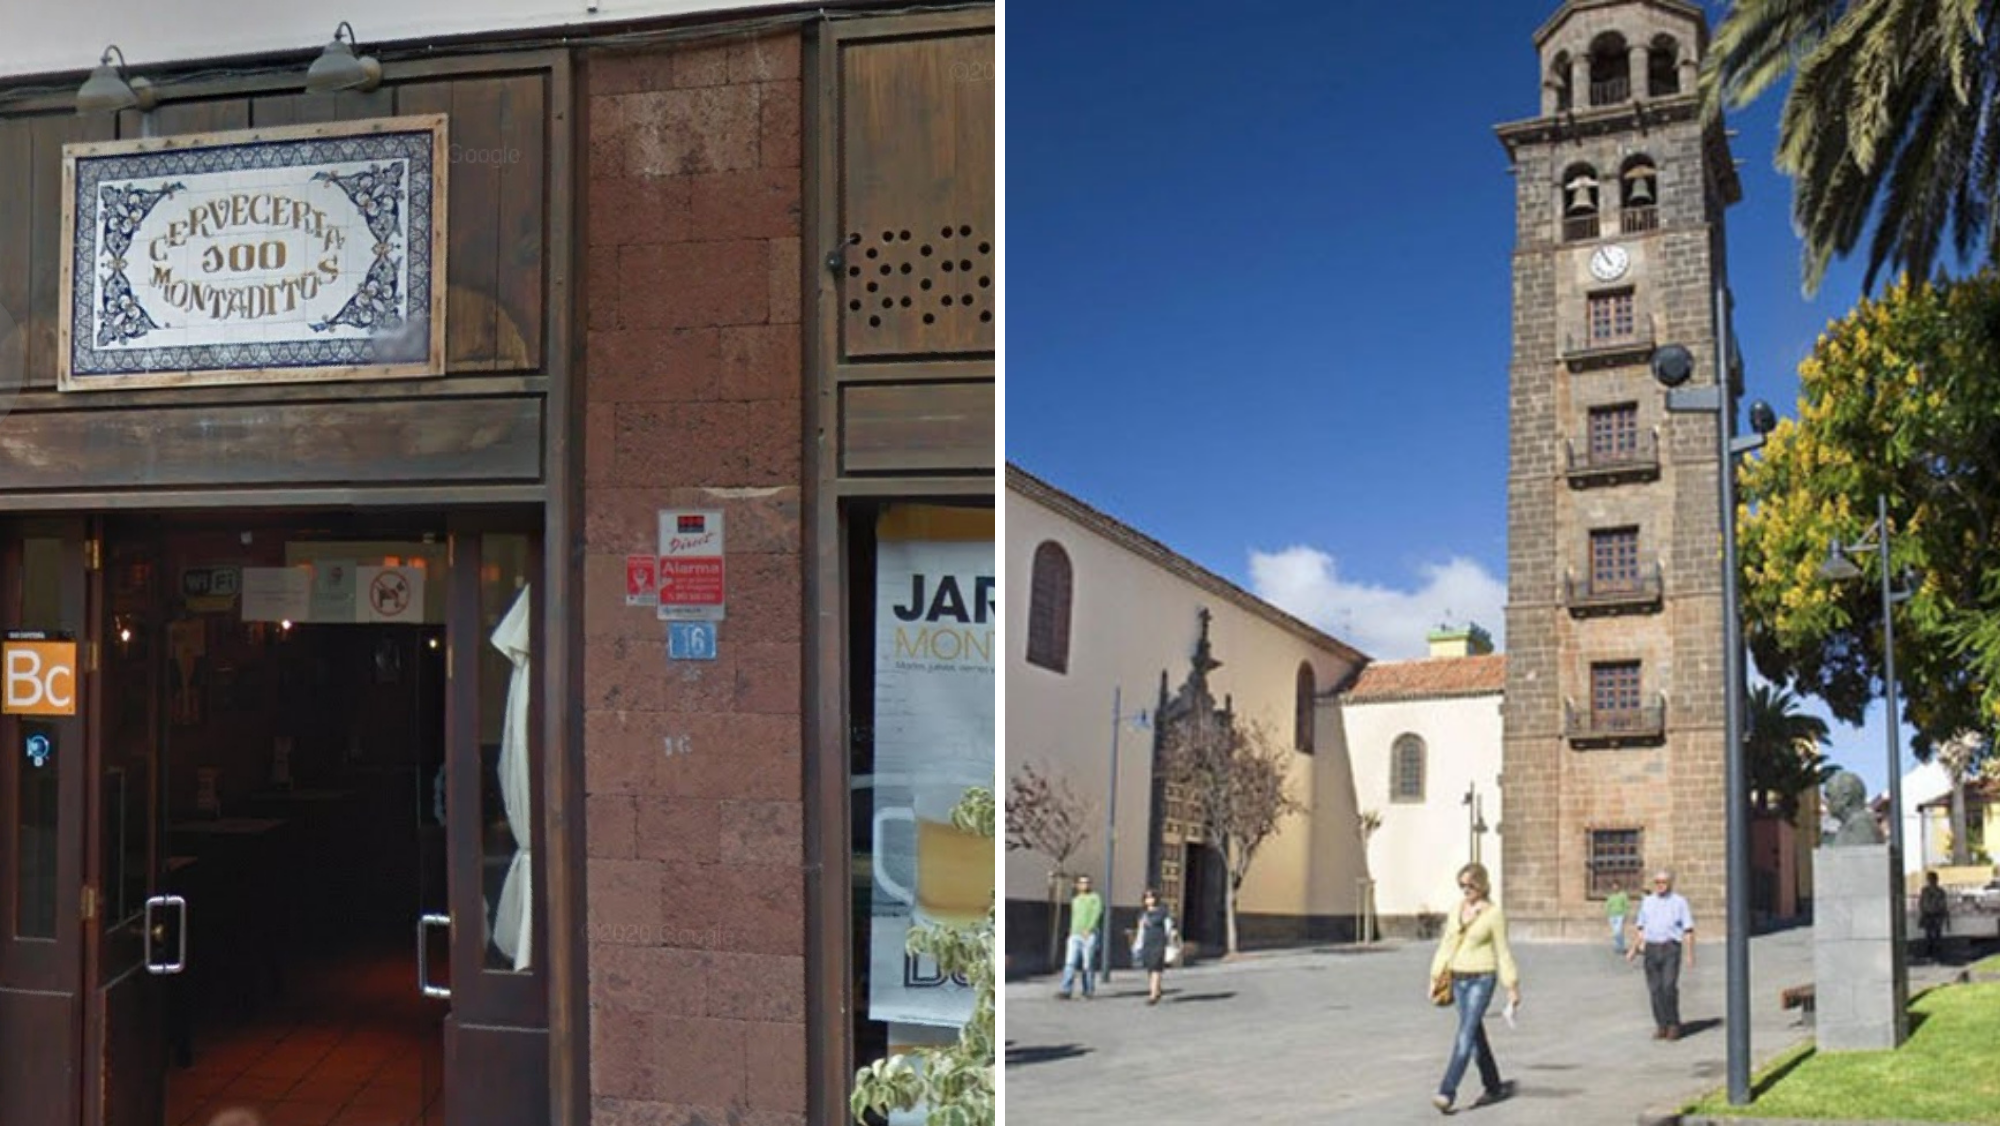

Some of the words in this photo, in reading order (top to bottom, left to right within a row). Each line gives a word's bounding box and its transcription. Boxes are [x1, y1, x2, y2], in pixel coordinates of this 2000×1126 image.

[151, 256, 339, 320] MONTADITOS
[662, 562, 720, 575] Alarma
[681, 627, 705, 657] 16
[895, 627, 995, 662] MON
[8, 650, 70, 707] Bc
